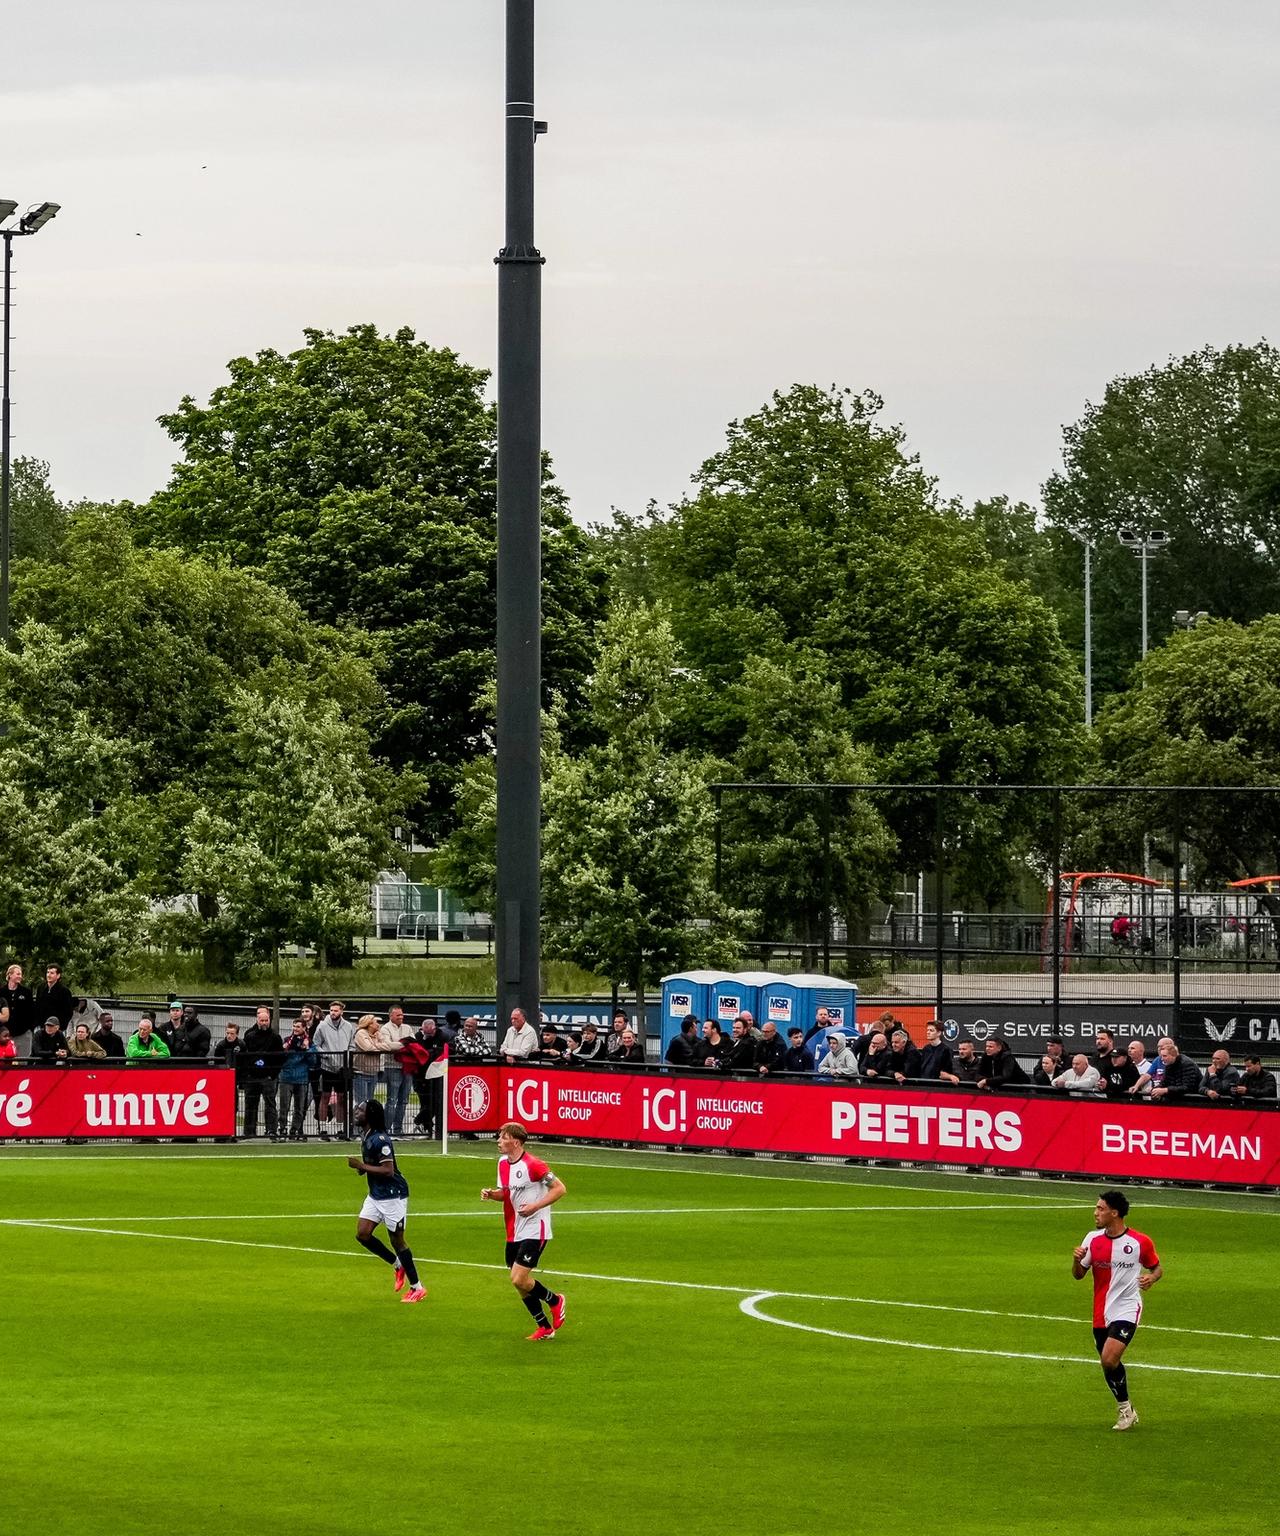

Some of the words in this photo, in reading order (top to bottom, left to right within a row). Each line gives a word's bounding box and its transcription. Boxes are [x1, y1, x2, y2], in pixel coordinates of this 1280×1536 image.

[719, 997, 737, 1009] MSR
[769, 998, 789, 1009] MSR
[84, 1079, 210, 1127] univé
[558, 1088, 622, 1105] INTELLIGENCE
[558, 1106, 592, 1121] GROUP
[696, 1097, 764, 1115] INTELLIGENCE
[696, 1115, 733, 1131] GROUP
[831, 1101, 1023, 1153] PEETERS
[1102, 1125, 1261, 1161] BREEMAN
